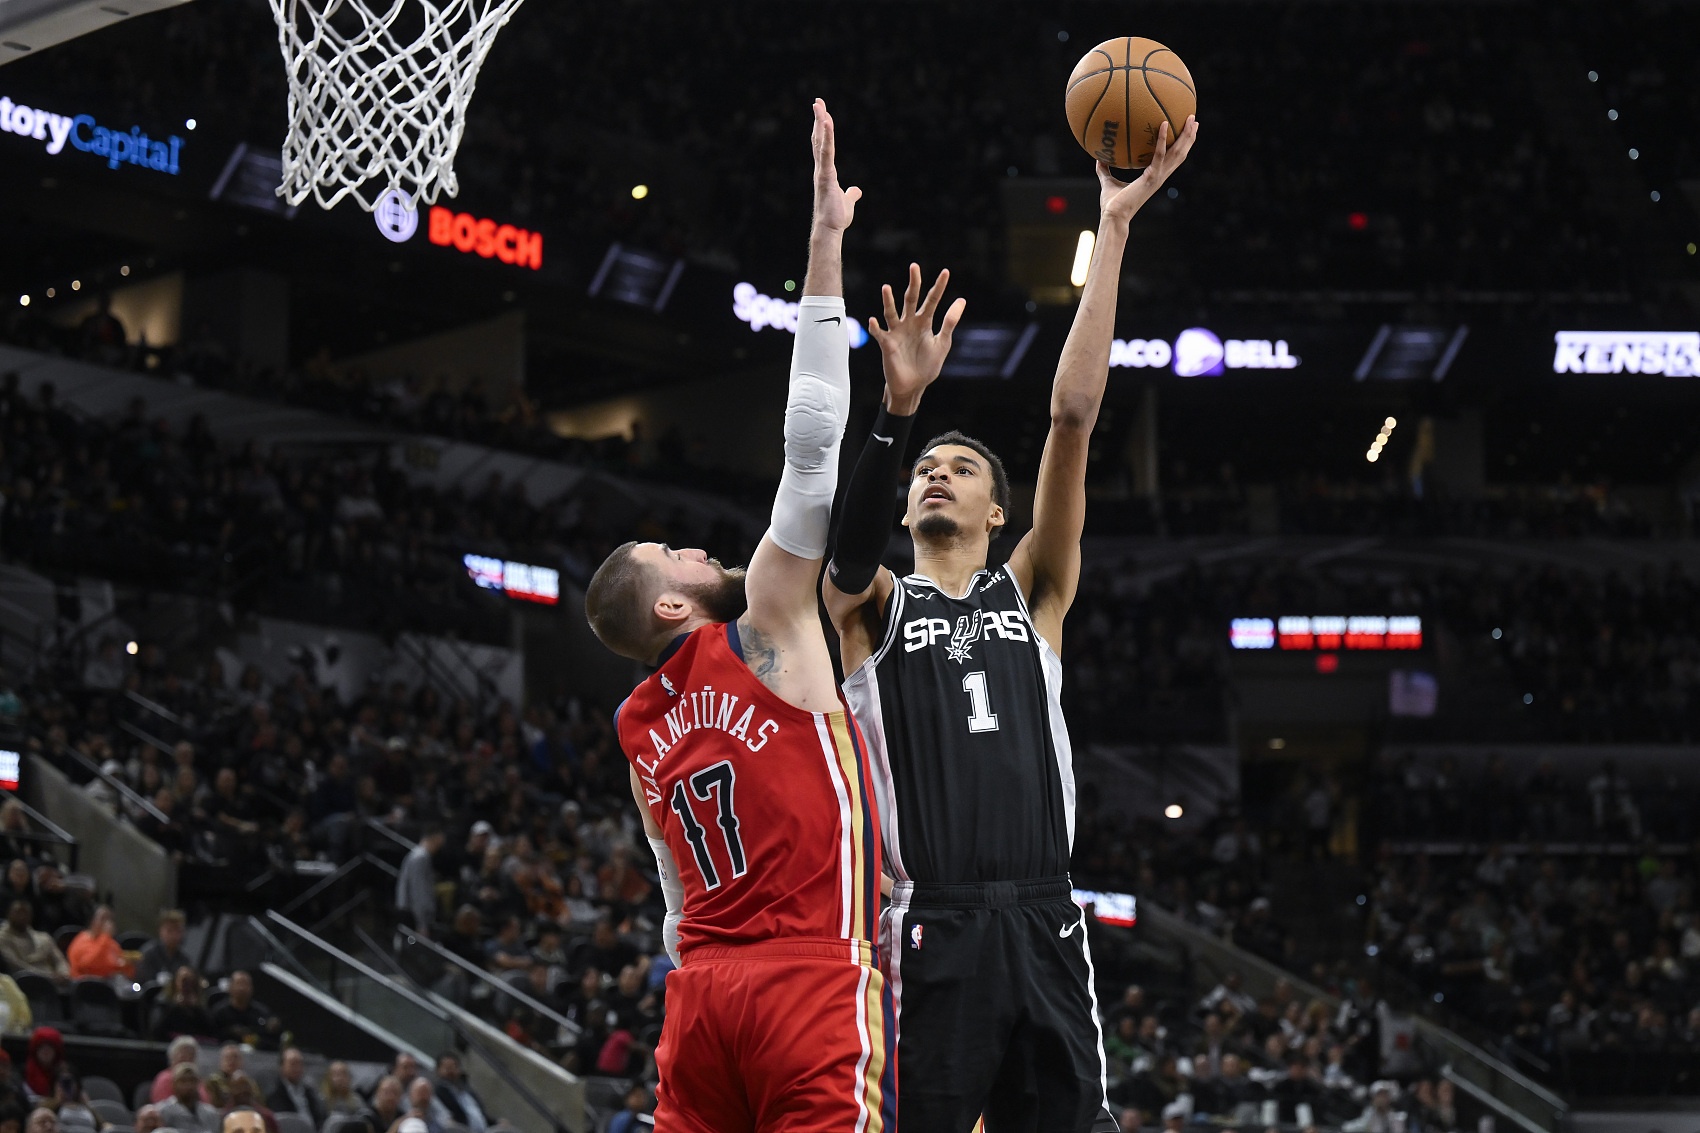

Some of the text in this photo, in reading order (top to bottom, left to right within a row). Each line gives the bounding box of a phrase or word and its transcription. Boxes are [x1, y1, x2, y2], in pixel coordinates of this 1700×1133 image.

[1095, 120, 1119, 166] lson
[429, 205, 542, 270] BOSCH
[1109, 338, 1297, 369] ACO BELL
[904, 609, 1029, 664] SPURS
[962, 671, 999, 733] 1
[636, 685, 779, 807] VALANČIŪNAS
[671, 760, 747, 891] 17
